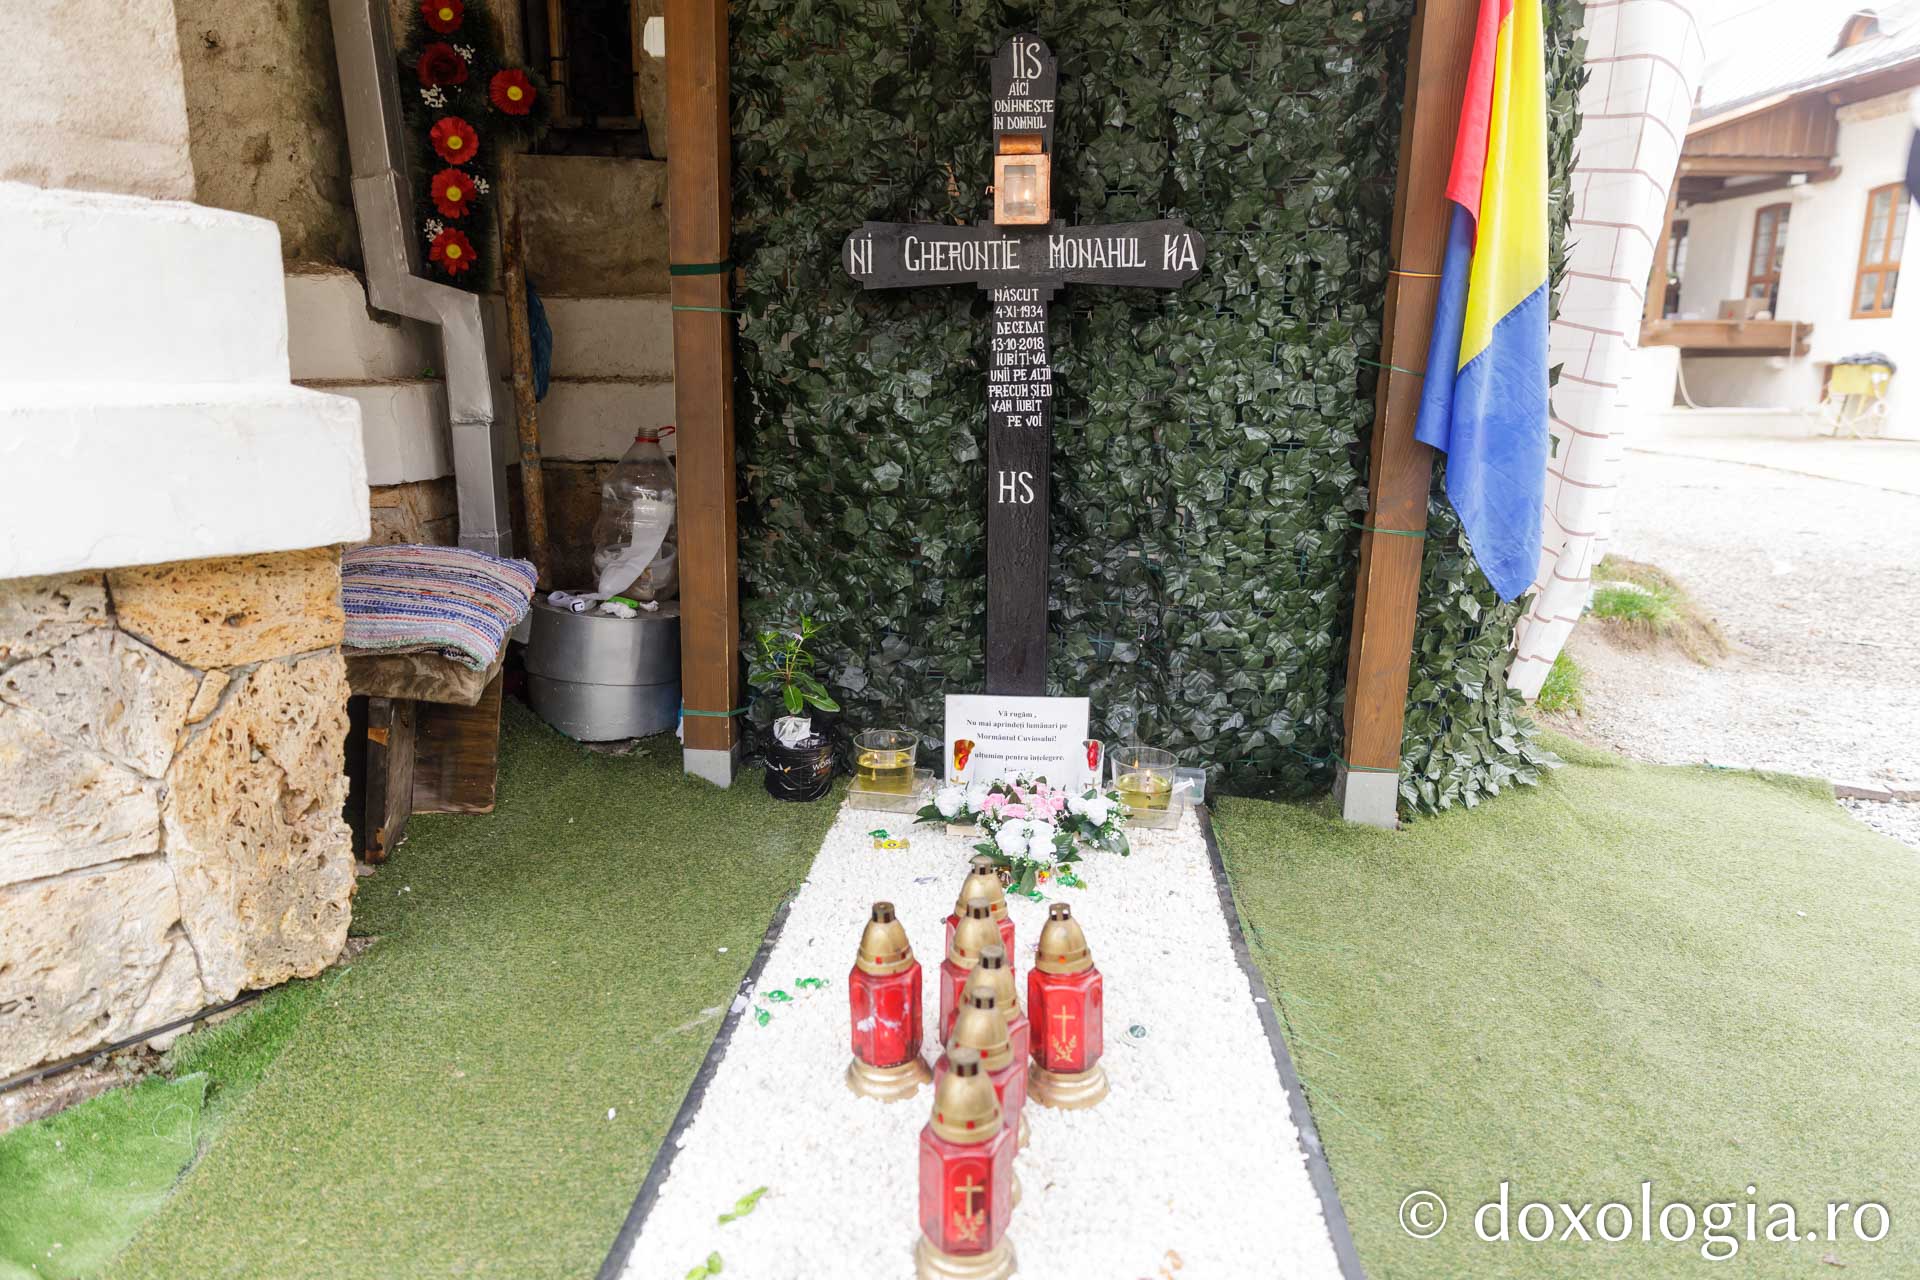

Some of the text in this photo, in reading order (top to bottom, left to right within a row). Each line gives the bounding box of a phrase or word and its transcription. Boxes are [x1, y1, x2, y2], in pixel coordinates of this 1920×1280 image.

[1007, 115, 1047, 130] DOMNUL
[996, 321, 1045, 335] DECEDAT
[1012, 369, 1028, 382] PE
[988, 384, 1028, 398] PRECUM
[1040, 384, 1053, 398] EU
[1007, 412, 1043, 427] PE VOI
[998, 470, 1034, 504] HS
[974, 752, 1004, 760] ulțumim
